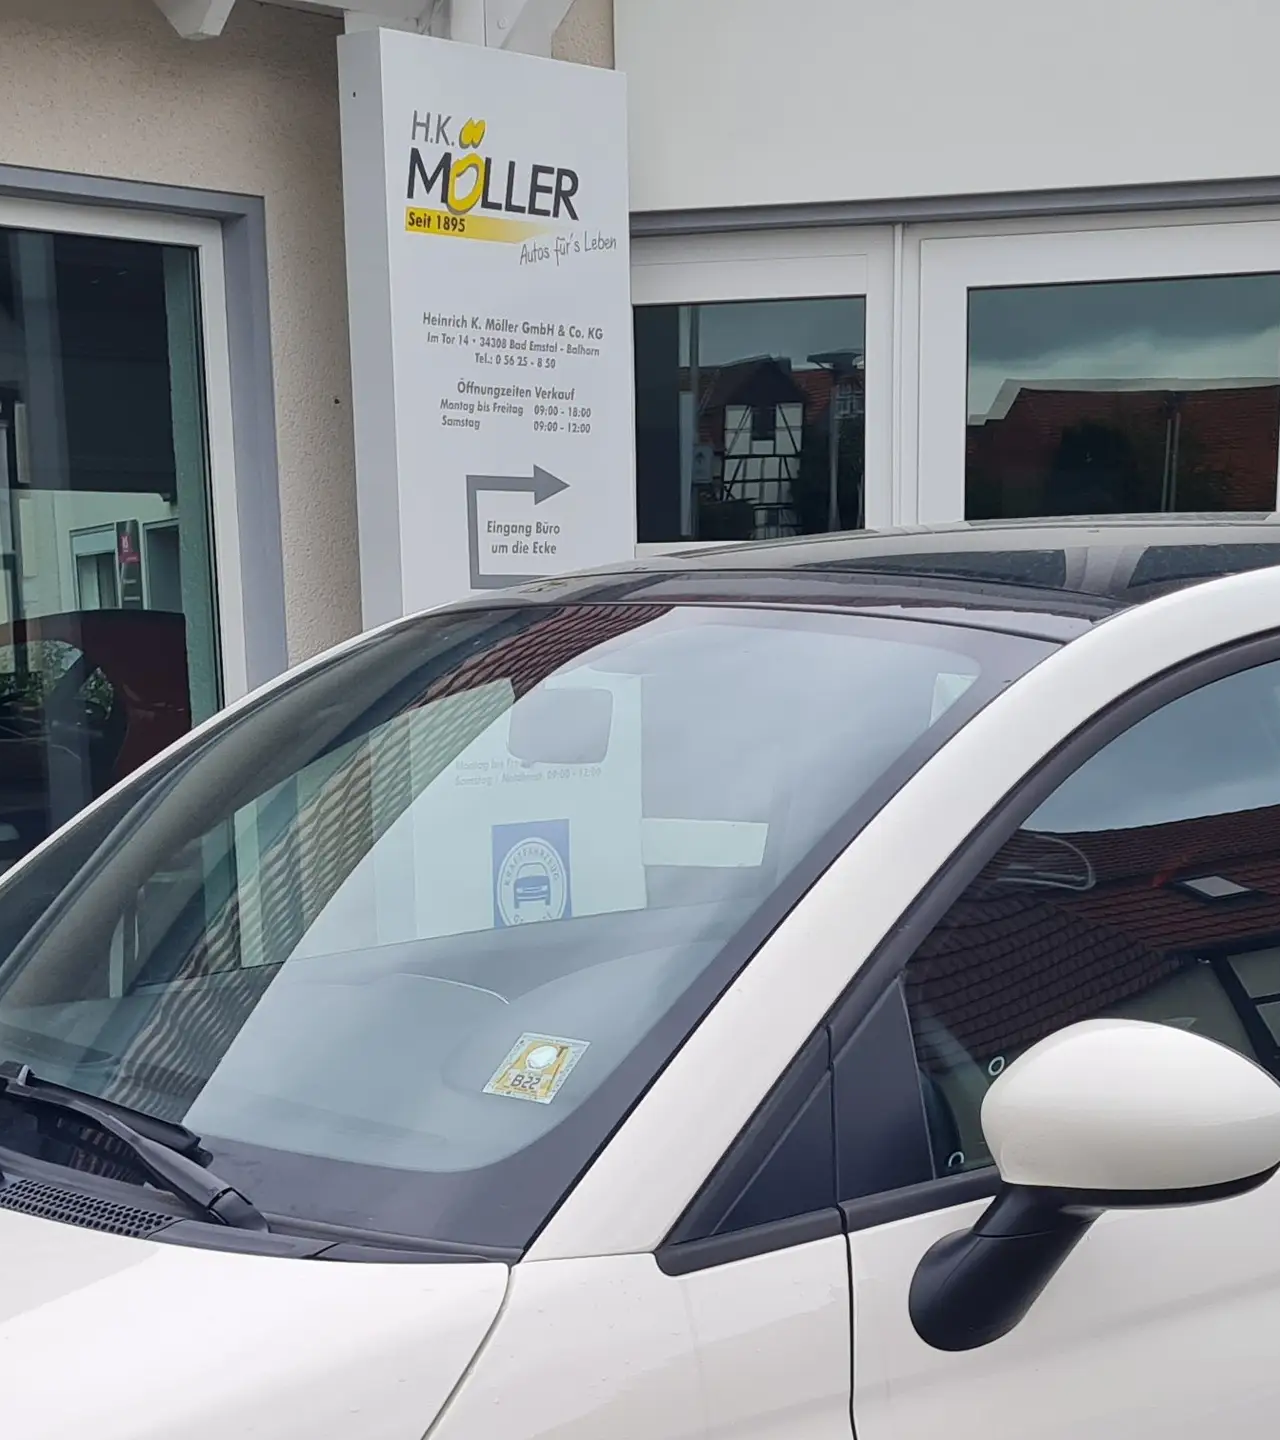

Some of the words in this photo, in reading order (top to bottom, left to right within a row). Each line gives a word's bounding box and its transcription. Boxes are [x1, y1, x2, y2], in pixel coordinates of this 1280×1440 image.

[411, 109, 455, 147] H.K.
[408, 211, 432, 230] Seit
[436, 214, 466, 233] 1895
[520, 243, 550, 266] Autos
[584, 231, 617, 253] Leben
[422, 312, 468, 329] Heinrich
[471, 316, 482, 330] K.
[485, 318, 519, 334] Möller
[522, 321, 555, 337] GmbH
[558, 325, 566, 338] &
[569, 326, 585, 339] Co.
[588, 327, 604, 340] KG
[427, 332, 439, 344] Im
[442, 333, 456, 346] Tor
[458, 334, 469, 347] 14
[479, 337, 507, 350] 34308
[509, 339, 527, 351] Bad
[529, 341, 558, 354] Emstal
[567, 344, 600, 357] Balhorn
[475, 352, 493, 365] Tel.:
[496, 353, 502, 366] 0
[503, 354, 515, 366] 56
[516, 355, 528, 367] 25
[537, 356, 543, 369] 8
[545, 357, 556, 369] 50
[535, 386, 575, 401] Verkauf
[440, 398, 475, 414] Montag
[477, 400, 491, 413] bis
[493, 402, 524, 416] Freitag
[534, 404, 559, 417] 09:00
[567, 406, 592, 418] 18:00
[441, 416, 480, 430] Samstag
[533, 420, 558, 433] 09:00
[486, 520, 532, 537] Eingang
[535, 521, 560, 535] Büro
[491, 543, 509, 554] um
[511, 541, 529, 554] die
[532, 541, 557, 555] Ecke
